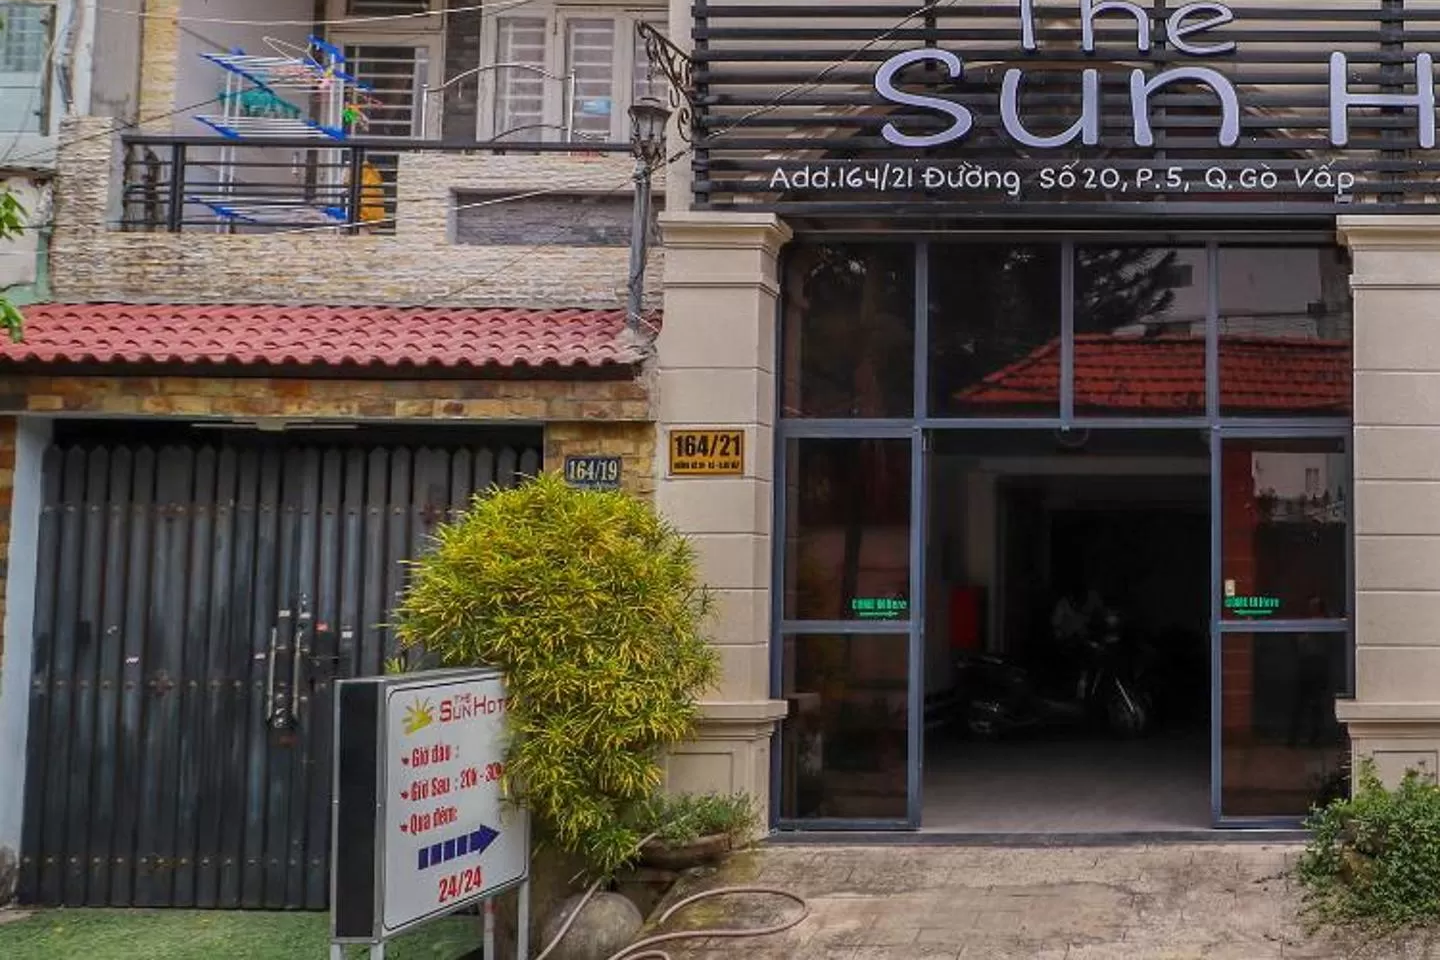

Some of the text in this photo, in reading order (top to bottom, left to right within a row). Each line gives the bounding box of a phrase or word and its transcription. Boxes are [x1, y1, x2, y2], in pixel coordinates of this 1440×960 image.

[874, 48, 1241, 149] Sun
[919, 159, 1021, 196] Đường
[1294, 158, 1356, 195] Vấp
[674, 434, 740, 458] 164/21
[569, 459, 618, 481] 164/19
[438, 865, 482, 903] 24/24
